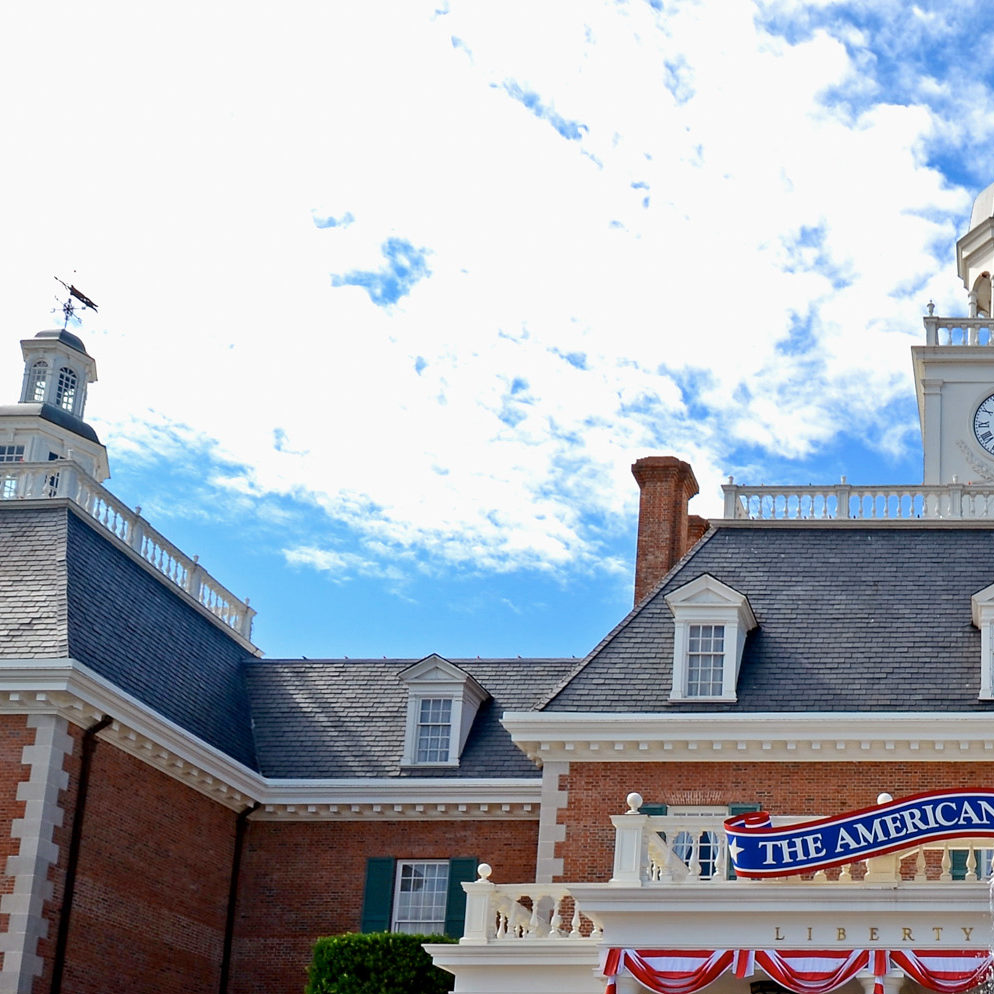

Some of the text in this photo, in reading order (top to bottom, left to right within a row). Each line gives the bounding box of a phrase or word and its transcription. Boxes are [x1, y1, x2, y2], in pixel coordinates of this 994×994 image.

[982, 407, 993, 416] X
[759, 834, 826, 865] THE
[775, 926, 974, 942] LIBERTY
